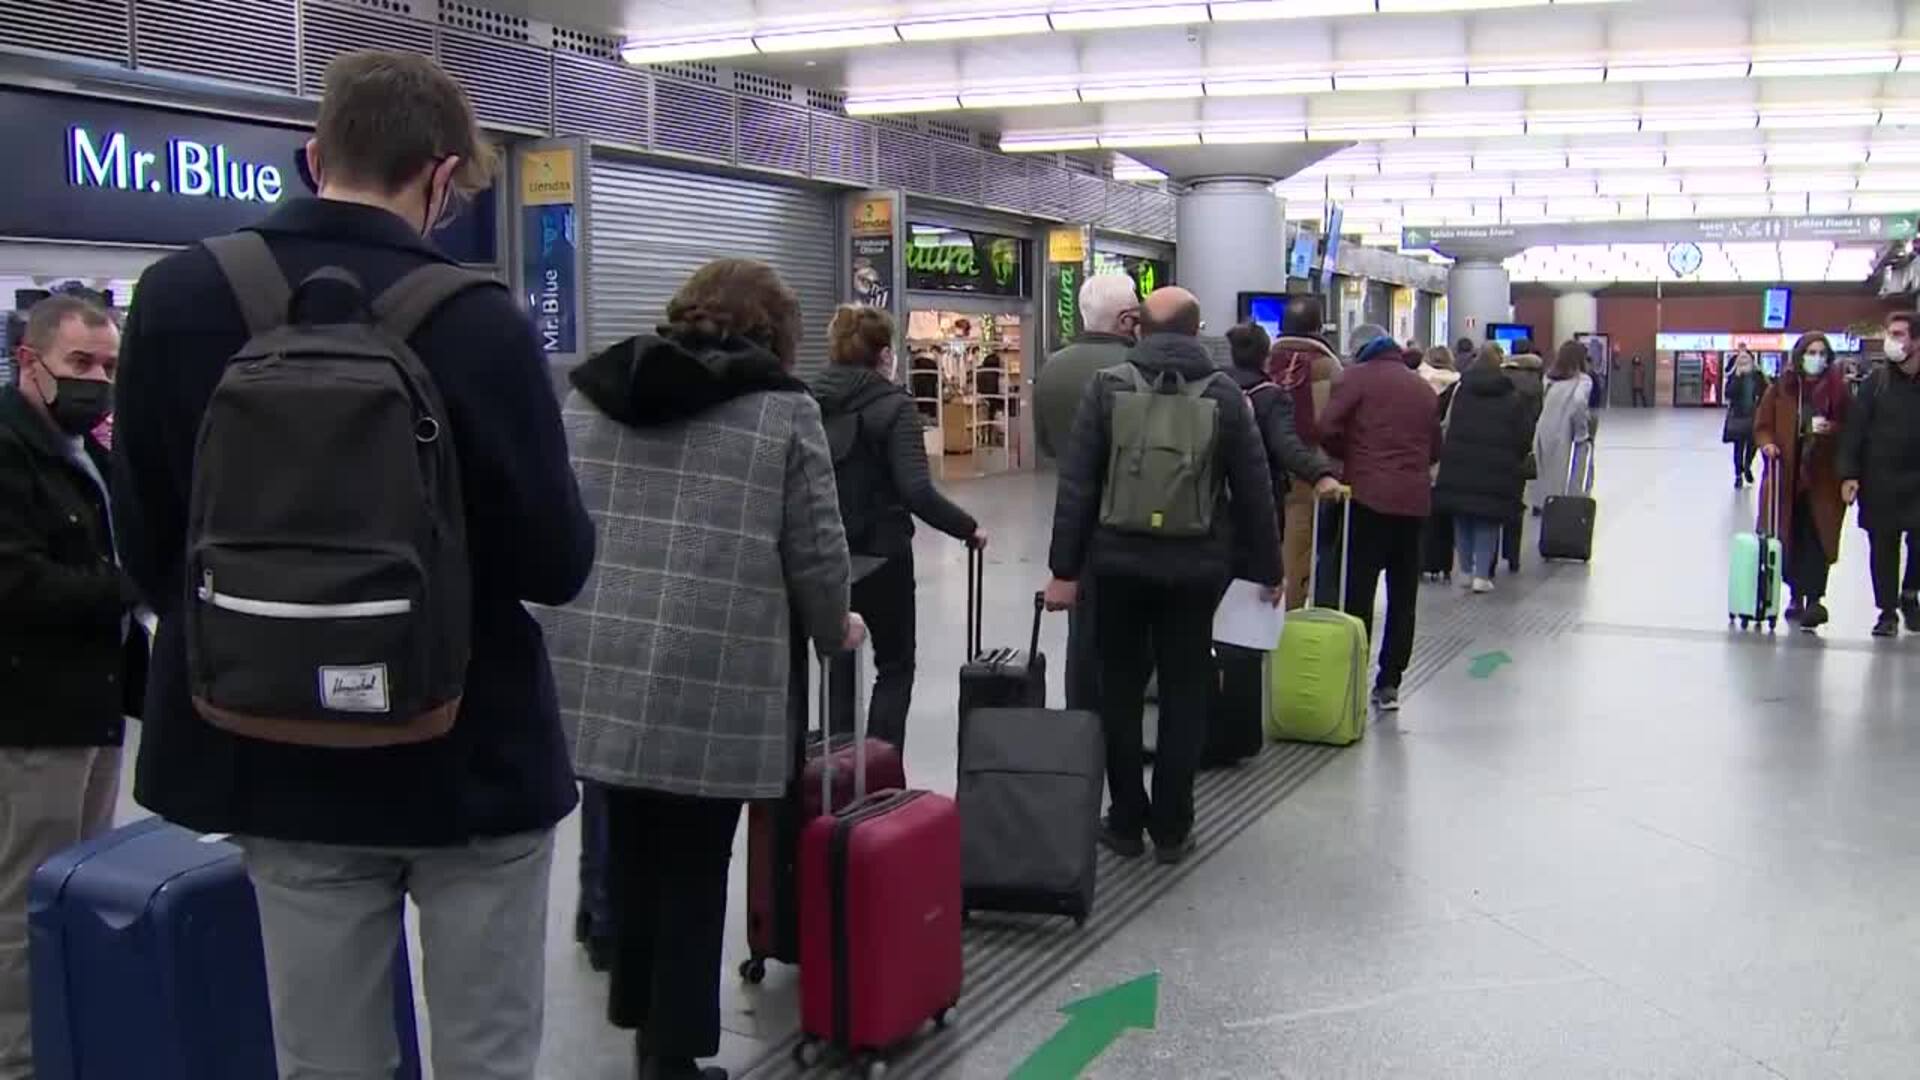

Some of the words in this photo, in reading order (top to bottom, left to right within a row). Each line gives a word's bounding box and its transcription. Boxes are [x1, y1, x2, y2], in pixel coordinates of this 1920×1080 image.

[66, 124, 161, 194] Mr.
[168, 138, 283, 203] Blue
[542, 269, 560, 314] Blue
[543, 316, 560, 351] Mr.
